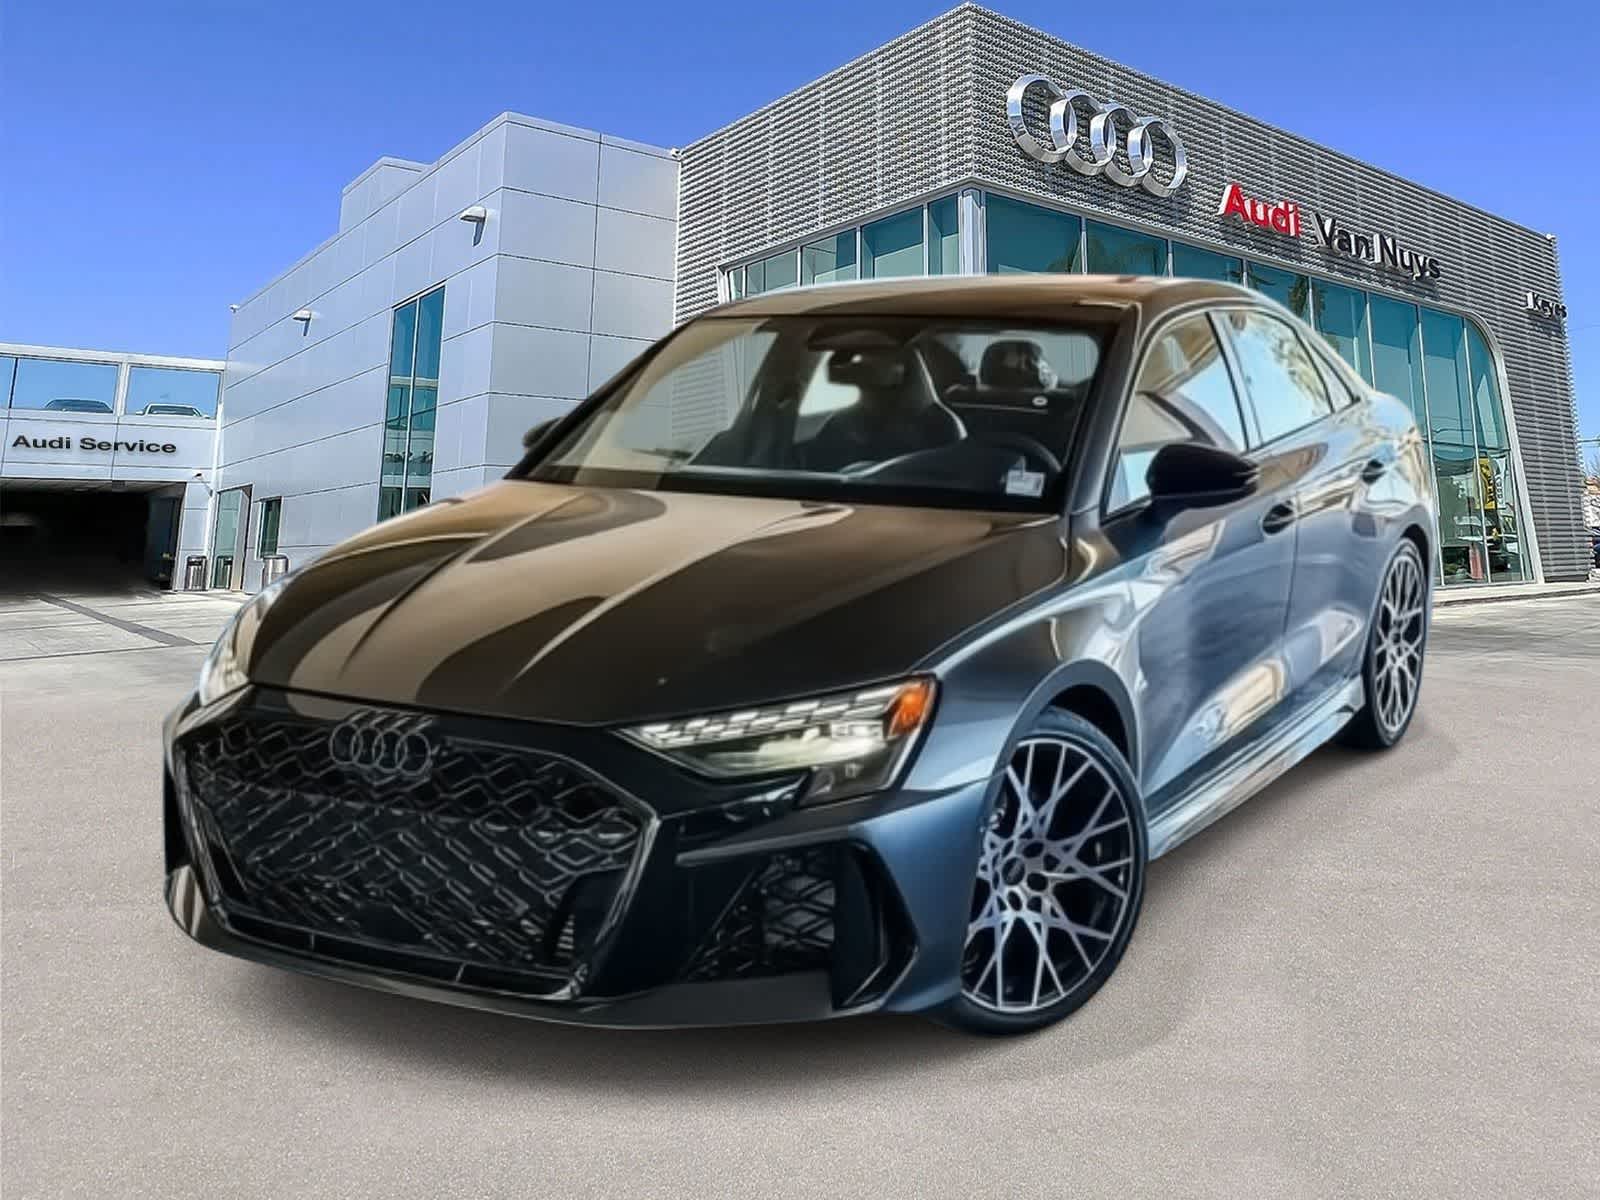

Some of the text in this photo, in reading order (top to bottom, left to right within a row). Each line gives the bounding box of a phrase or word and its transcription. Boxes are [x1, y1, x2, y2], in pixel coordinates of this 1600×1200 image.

[1219, 182, 1441, 281] Audi Van Nuys
[12, 435, 177, 453] Audi Service
